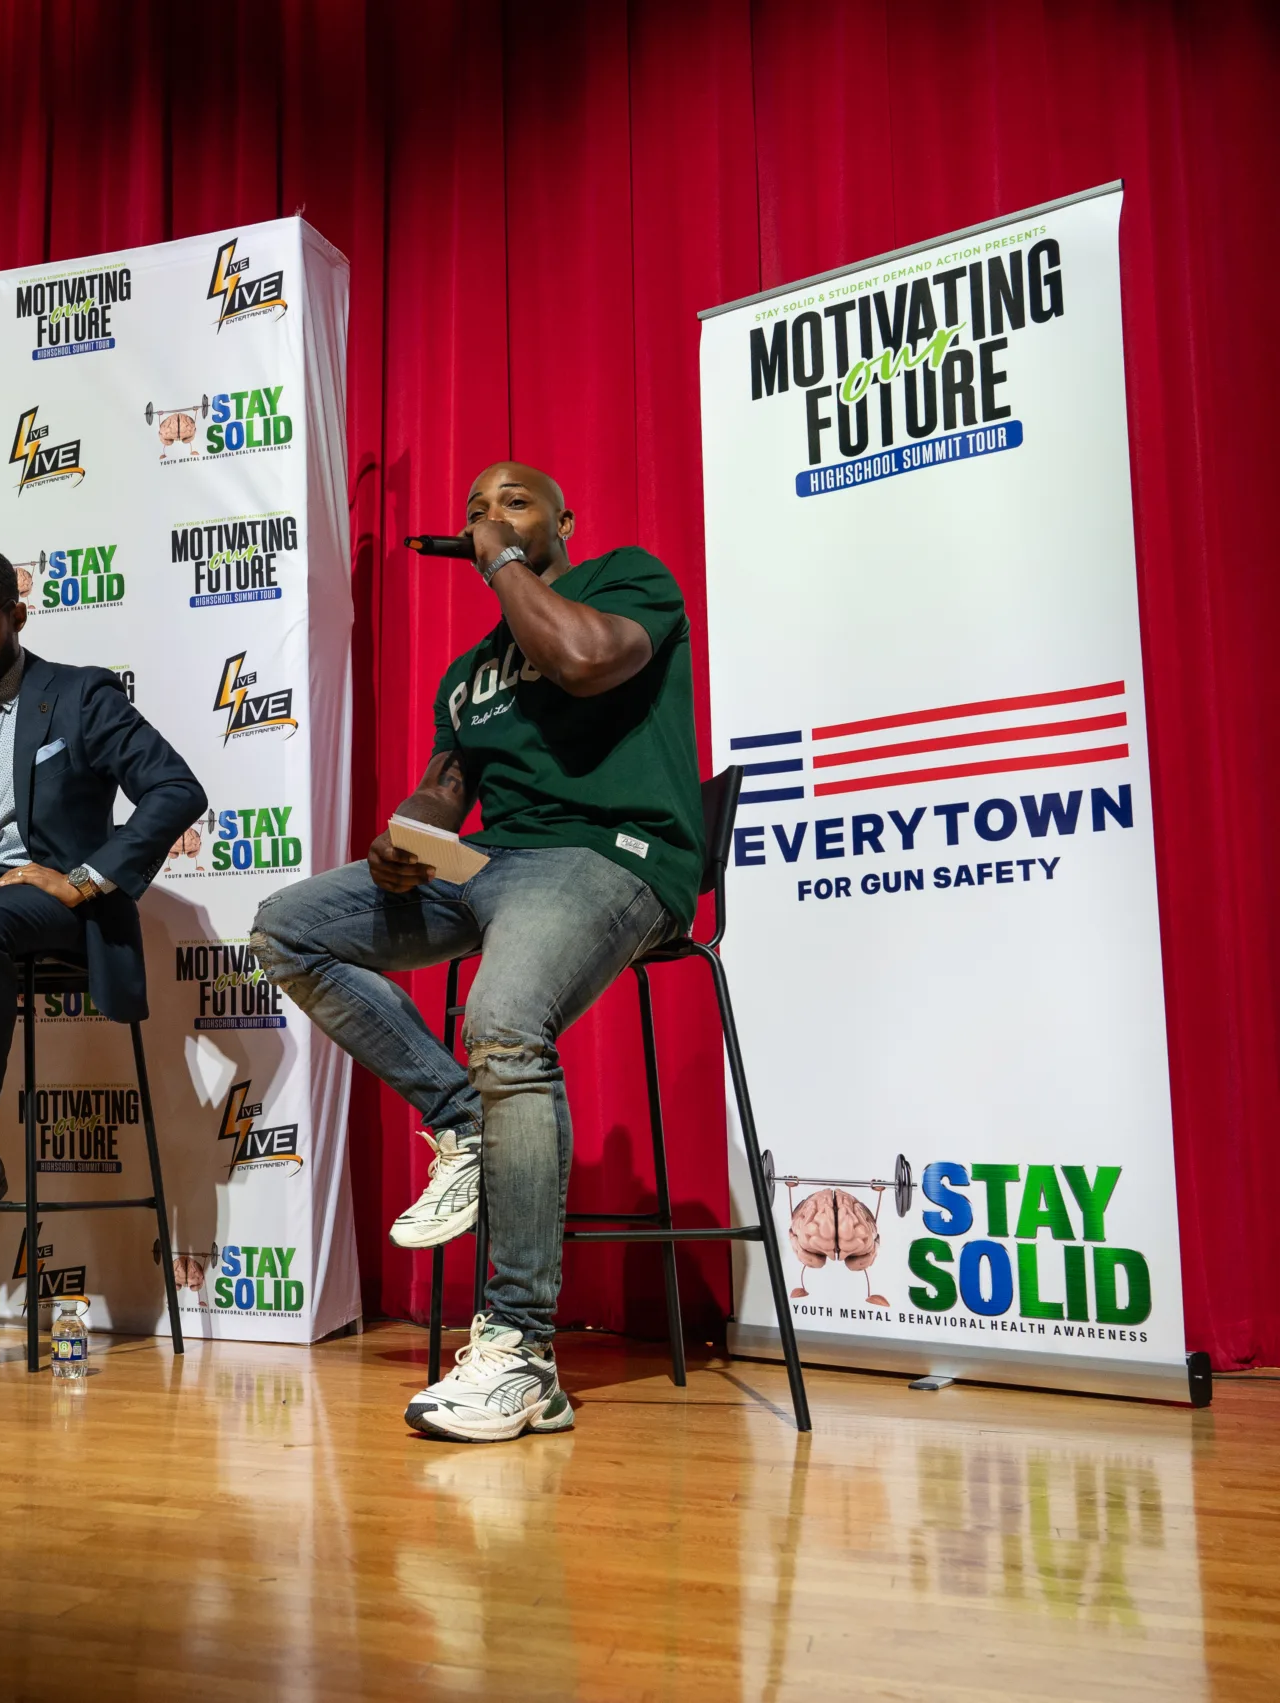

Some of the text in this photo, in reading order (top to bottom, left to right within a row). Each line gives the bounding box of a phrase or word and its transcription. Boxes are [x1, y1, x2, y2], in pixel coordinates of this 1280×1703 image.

[755, 225, 1047, 322] STAY SOLID & STUDENT DEMAND ACTION PRESENTS
[17, 268, 131, 318] MOTIVATING
[38, 305, 111, 348] FUTURE
[50, 297, 97, 324] our
[226, 307, 275, 324] ENTERTAINMENT
[749, 238, 1064, 401] MOTIVATING
[38, 340, 109, 358] HIGHSCHOOL SUMMIT TOUR
[839, 321, 967, 403] our
[212, 386, 284, 423] STAY
[806, 337, 1011, 465] FUTURE
[207, 416, 292, 454] SOLID
[202, 452, 234, 460] BEHAVIORAL
[258, 445, 291, 453] AWARENESS
[809, 426, 1007, 492] HIGHSCHOOL SUMMIT TOUR
[26, 473, 73, 489] ENTERTAINMENT
[171, 516, 297, 563] MOTIVATING
[49, 545, 117, 579] STAY
[195, 553, 277, 594] FUTURE
[209, 544, 260, 571] our
[43, 573, 125, 608] SOLID
[196, 590, 276, 606] HIGHSCHOOL SUMMIT TOUR
[232, 724, 284, 739] ENTERTAINMENT
[218, 806, 292, 840] STAY
[733, 783, 1134, 867] EVERYTOWN
[212, 837, 302, 871] SOLID
[798, 856, 1060, 901] FOR GUN SAFETY
[214, 969, 264, 992] our
[200, 980, 283, 1016] FUTURE
[200, 1018, 280, 1029] HIGHSCHOOL SUMMIT TOUR
[41, 1126, 118, 1160] FUTURE
[41, 1162, 117, 1172] HIGHSCHOOL SUMMIT TOUR
[237, 1160, 290, 1172] ENTERTAINMENT
[922, 1161, 1123, 1242] STAY
[222, 1246, 296, 1278] STAY
[215, 1277, 304, 1311] SOLID
[908, 1238, 1152, 1326] SOLID
[793, 1304, 1148, 1343] YOUTH MENTAL BEHAVIORAL HEALTH AWARENESS
